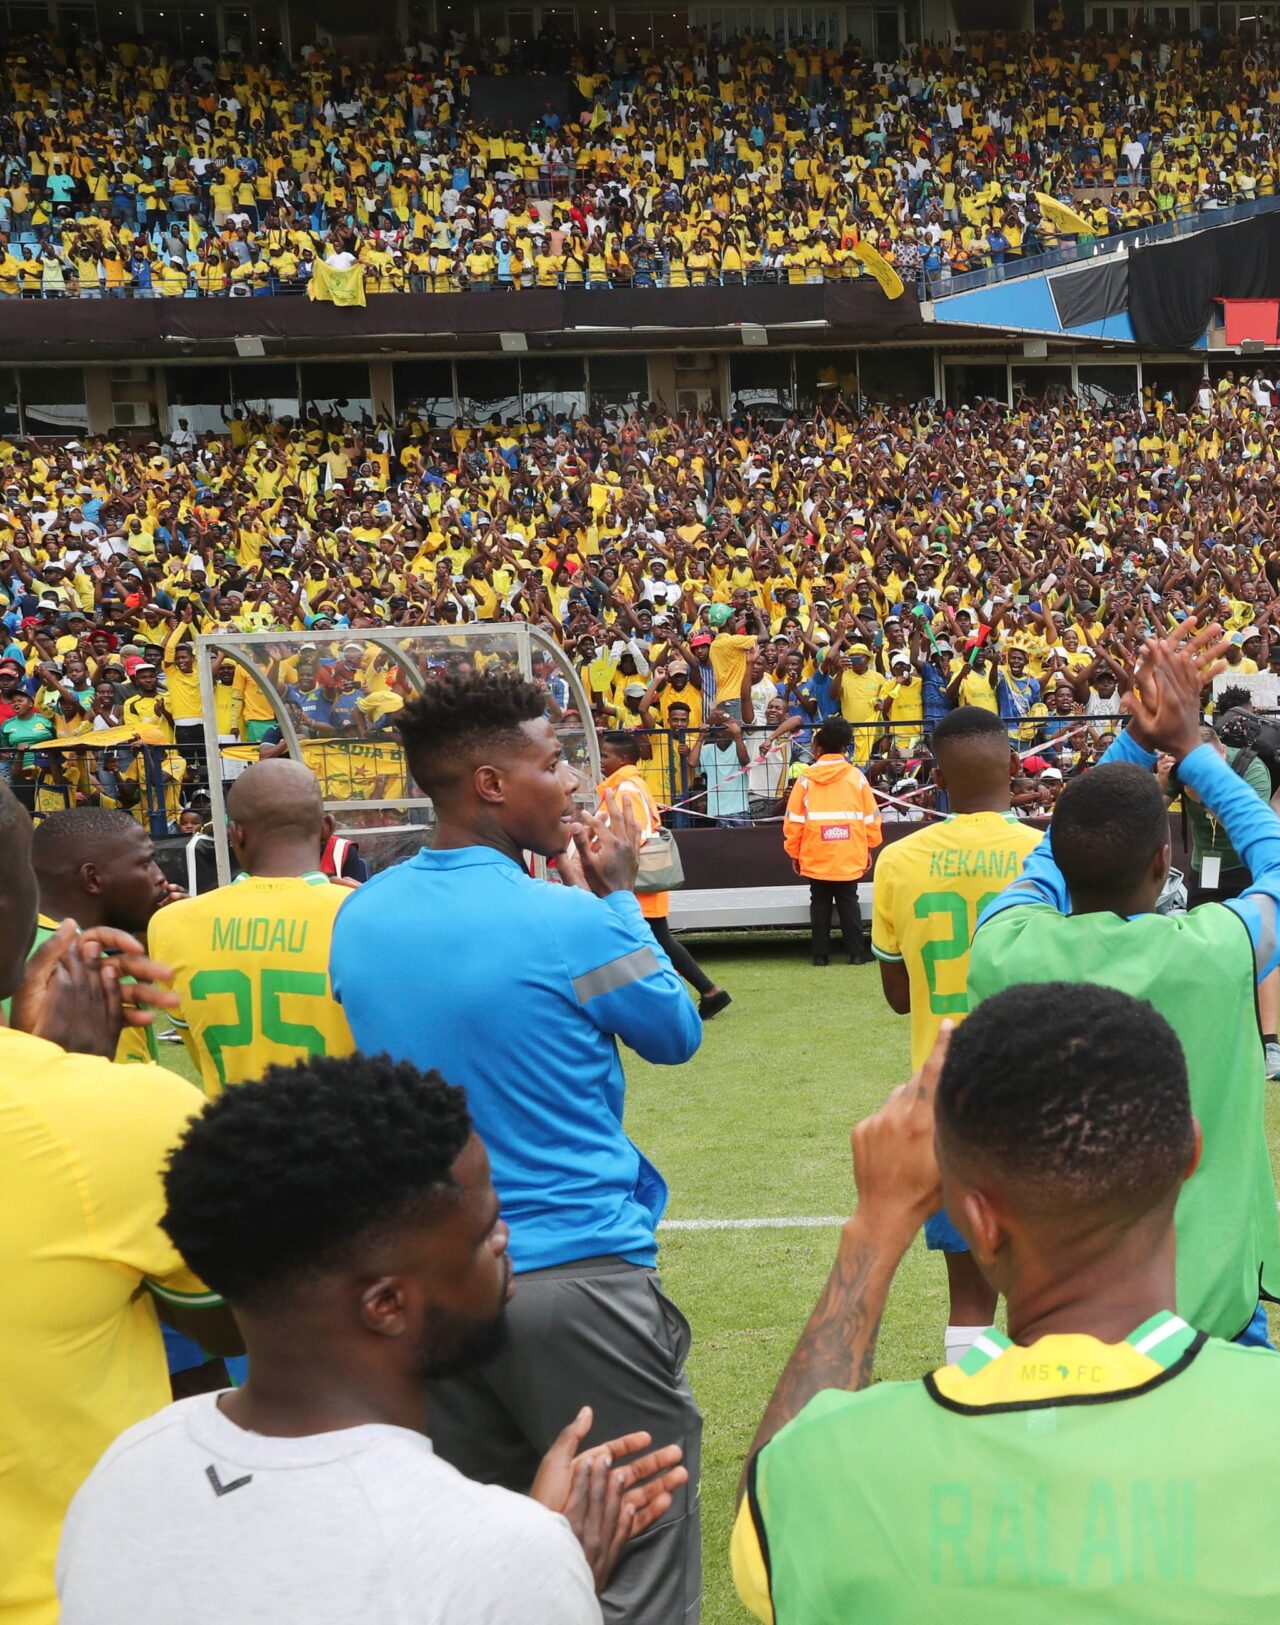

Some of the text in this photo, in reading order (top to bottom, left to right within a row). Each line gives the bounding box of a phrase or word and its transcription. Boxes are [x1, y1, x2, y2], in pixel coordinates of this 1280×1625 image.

[929, 849, 1018, 877] KEKANA
[212, 917, 308, 953] MUDAU
[914, 892, 1000, 1014] 2
[189, 969, 327, 1088] 25
[1021, 1364, 1102, 1383] MS FC
[928, 1478, 1196, 1586] RALANI
